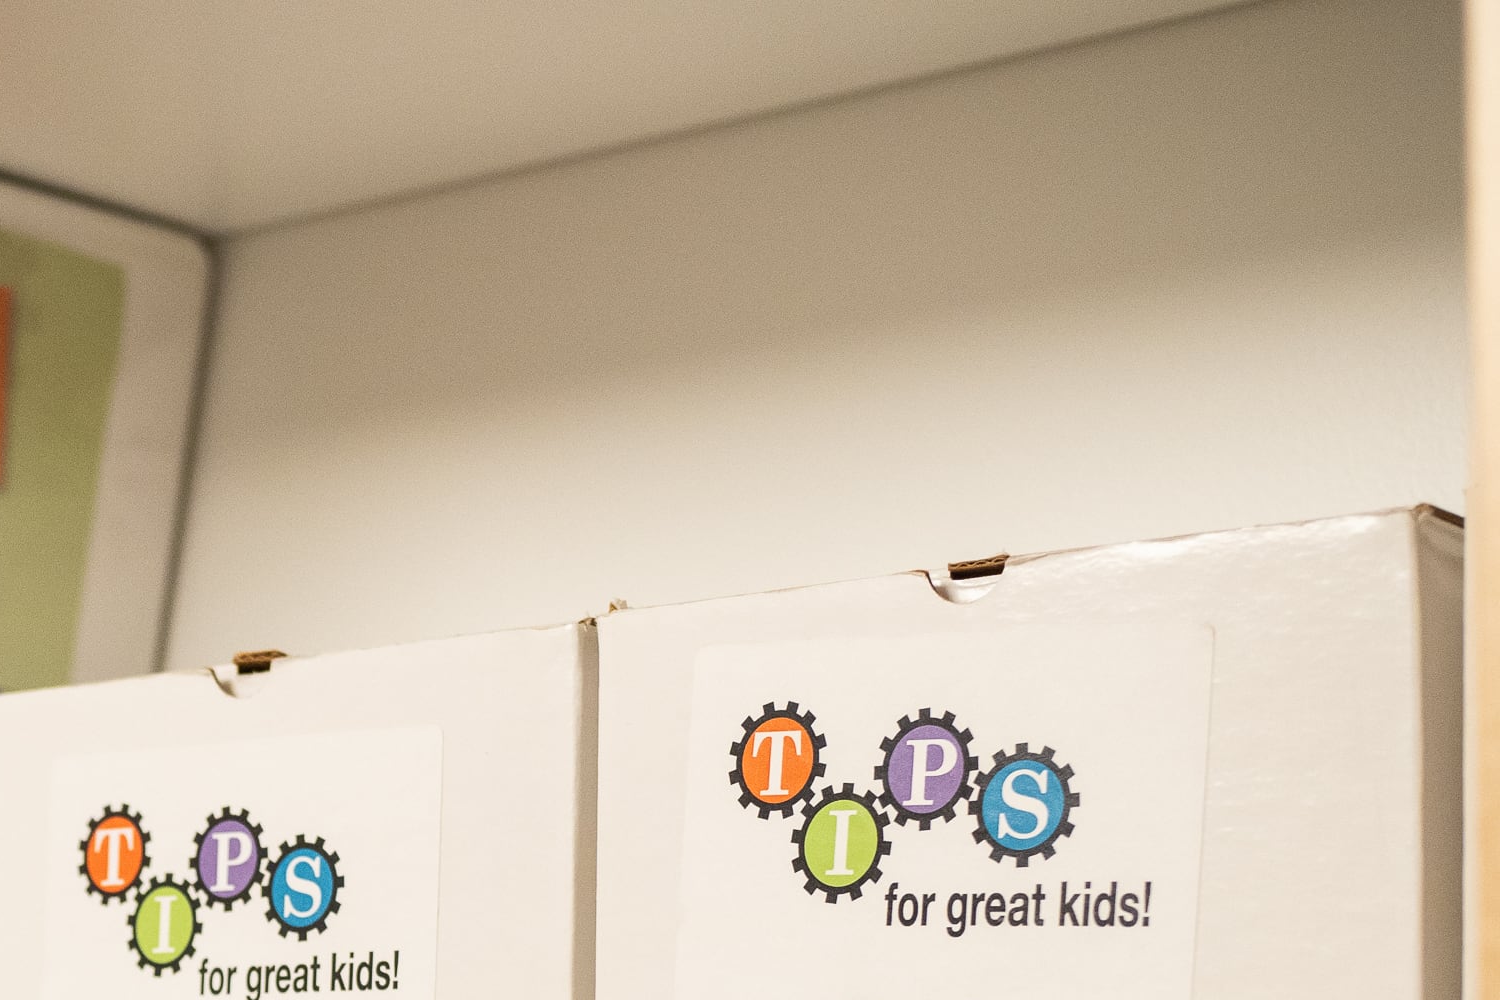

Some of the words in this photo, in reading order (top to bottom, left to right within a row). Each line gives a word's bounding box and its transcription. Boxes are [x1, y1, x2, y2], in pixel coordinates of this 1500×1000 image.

[750, 728, 1052, 877] TIPS
[92, 825, 324, 957] TIPS
[885, 883, 936, 927] for
[946, 883, 1046, 938] great
[1059, 881, 1152, 927] kids!
[198, 959, 237, 995] for
[331, 950, 400, 992] kids!
